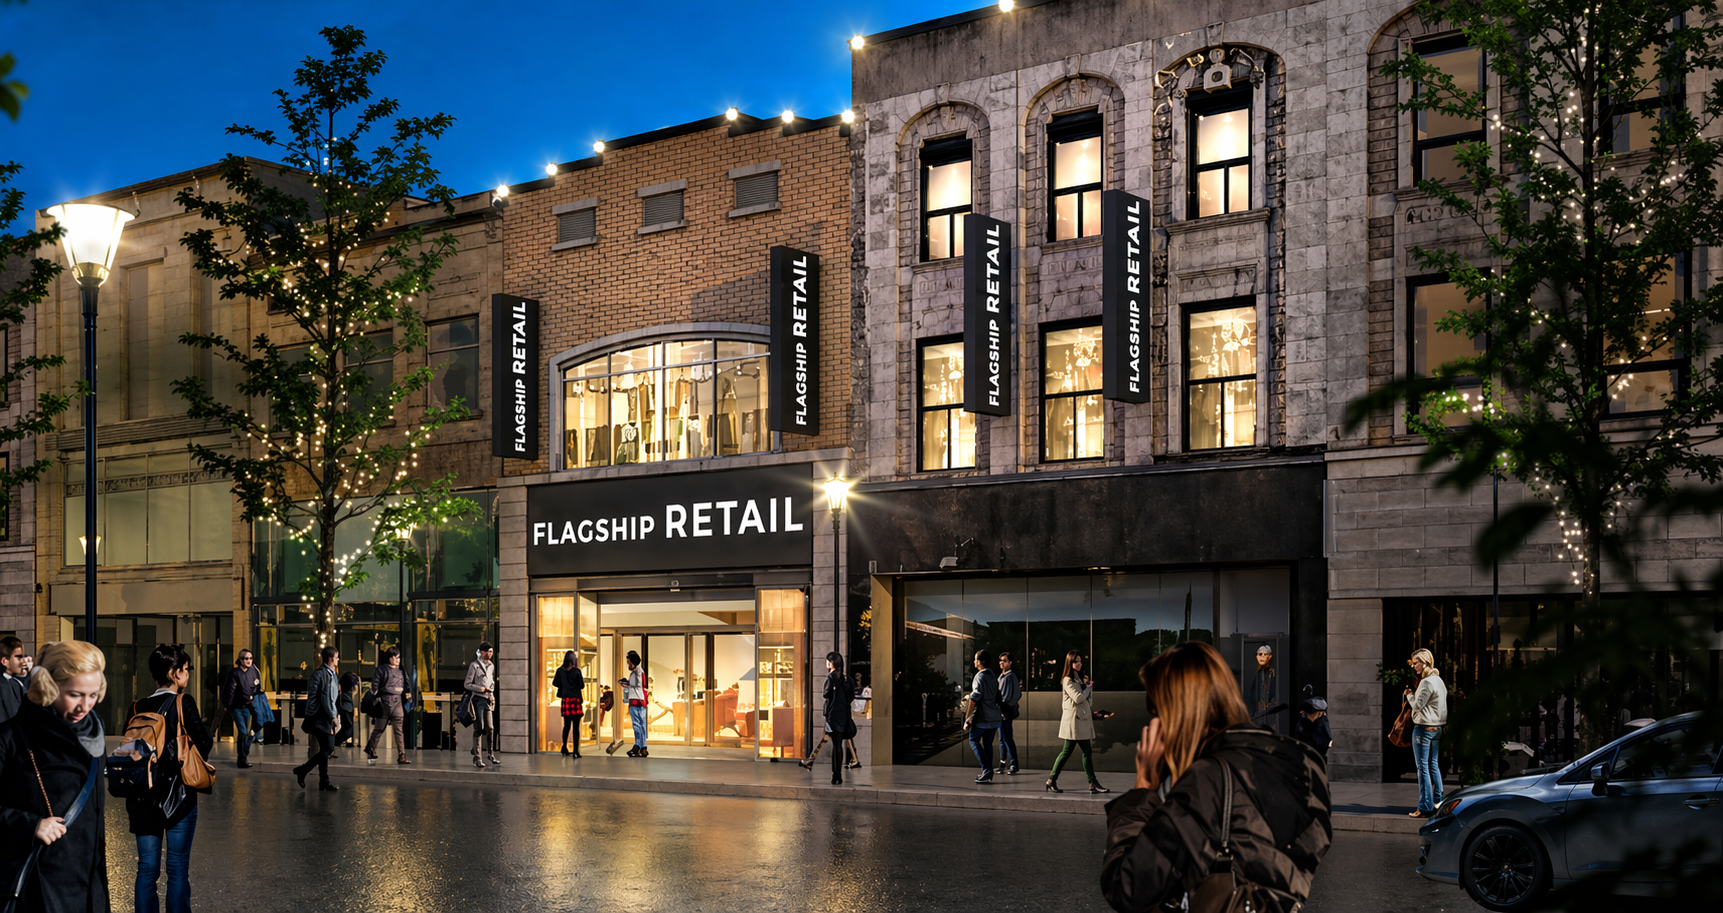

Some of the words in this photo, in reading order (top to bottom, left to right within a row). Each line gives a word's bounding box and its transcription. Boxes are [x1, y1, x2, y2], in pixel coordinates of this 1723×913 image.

[986, 224, 1000, 314] RETAIL
[1127, 200, 1141, 294] RETAIL
[512, 301, 526, 375] RETAIL
[792, 255, 807, 338] RETAIL
[795, 342, 807, 426] FLAGSHIP
[988, 318, 1000, 407] FLAGSHIP
[1129, 299, 1140, 393] FLAGSHIP
[514, 378, 526, 453] FLAGSHIP
[533, 515, 655, 546] FLAGSHIP
[665, 496, 804, 539] RETAIL
